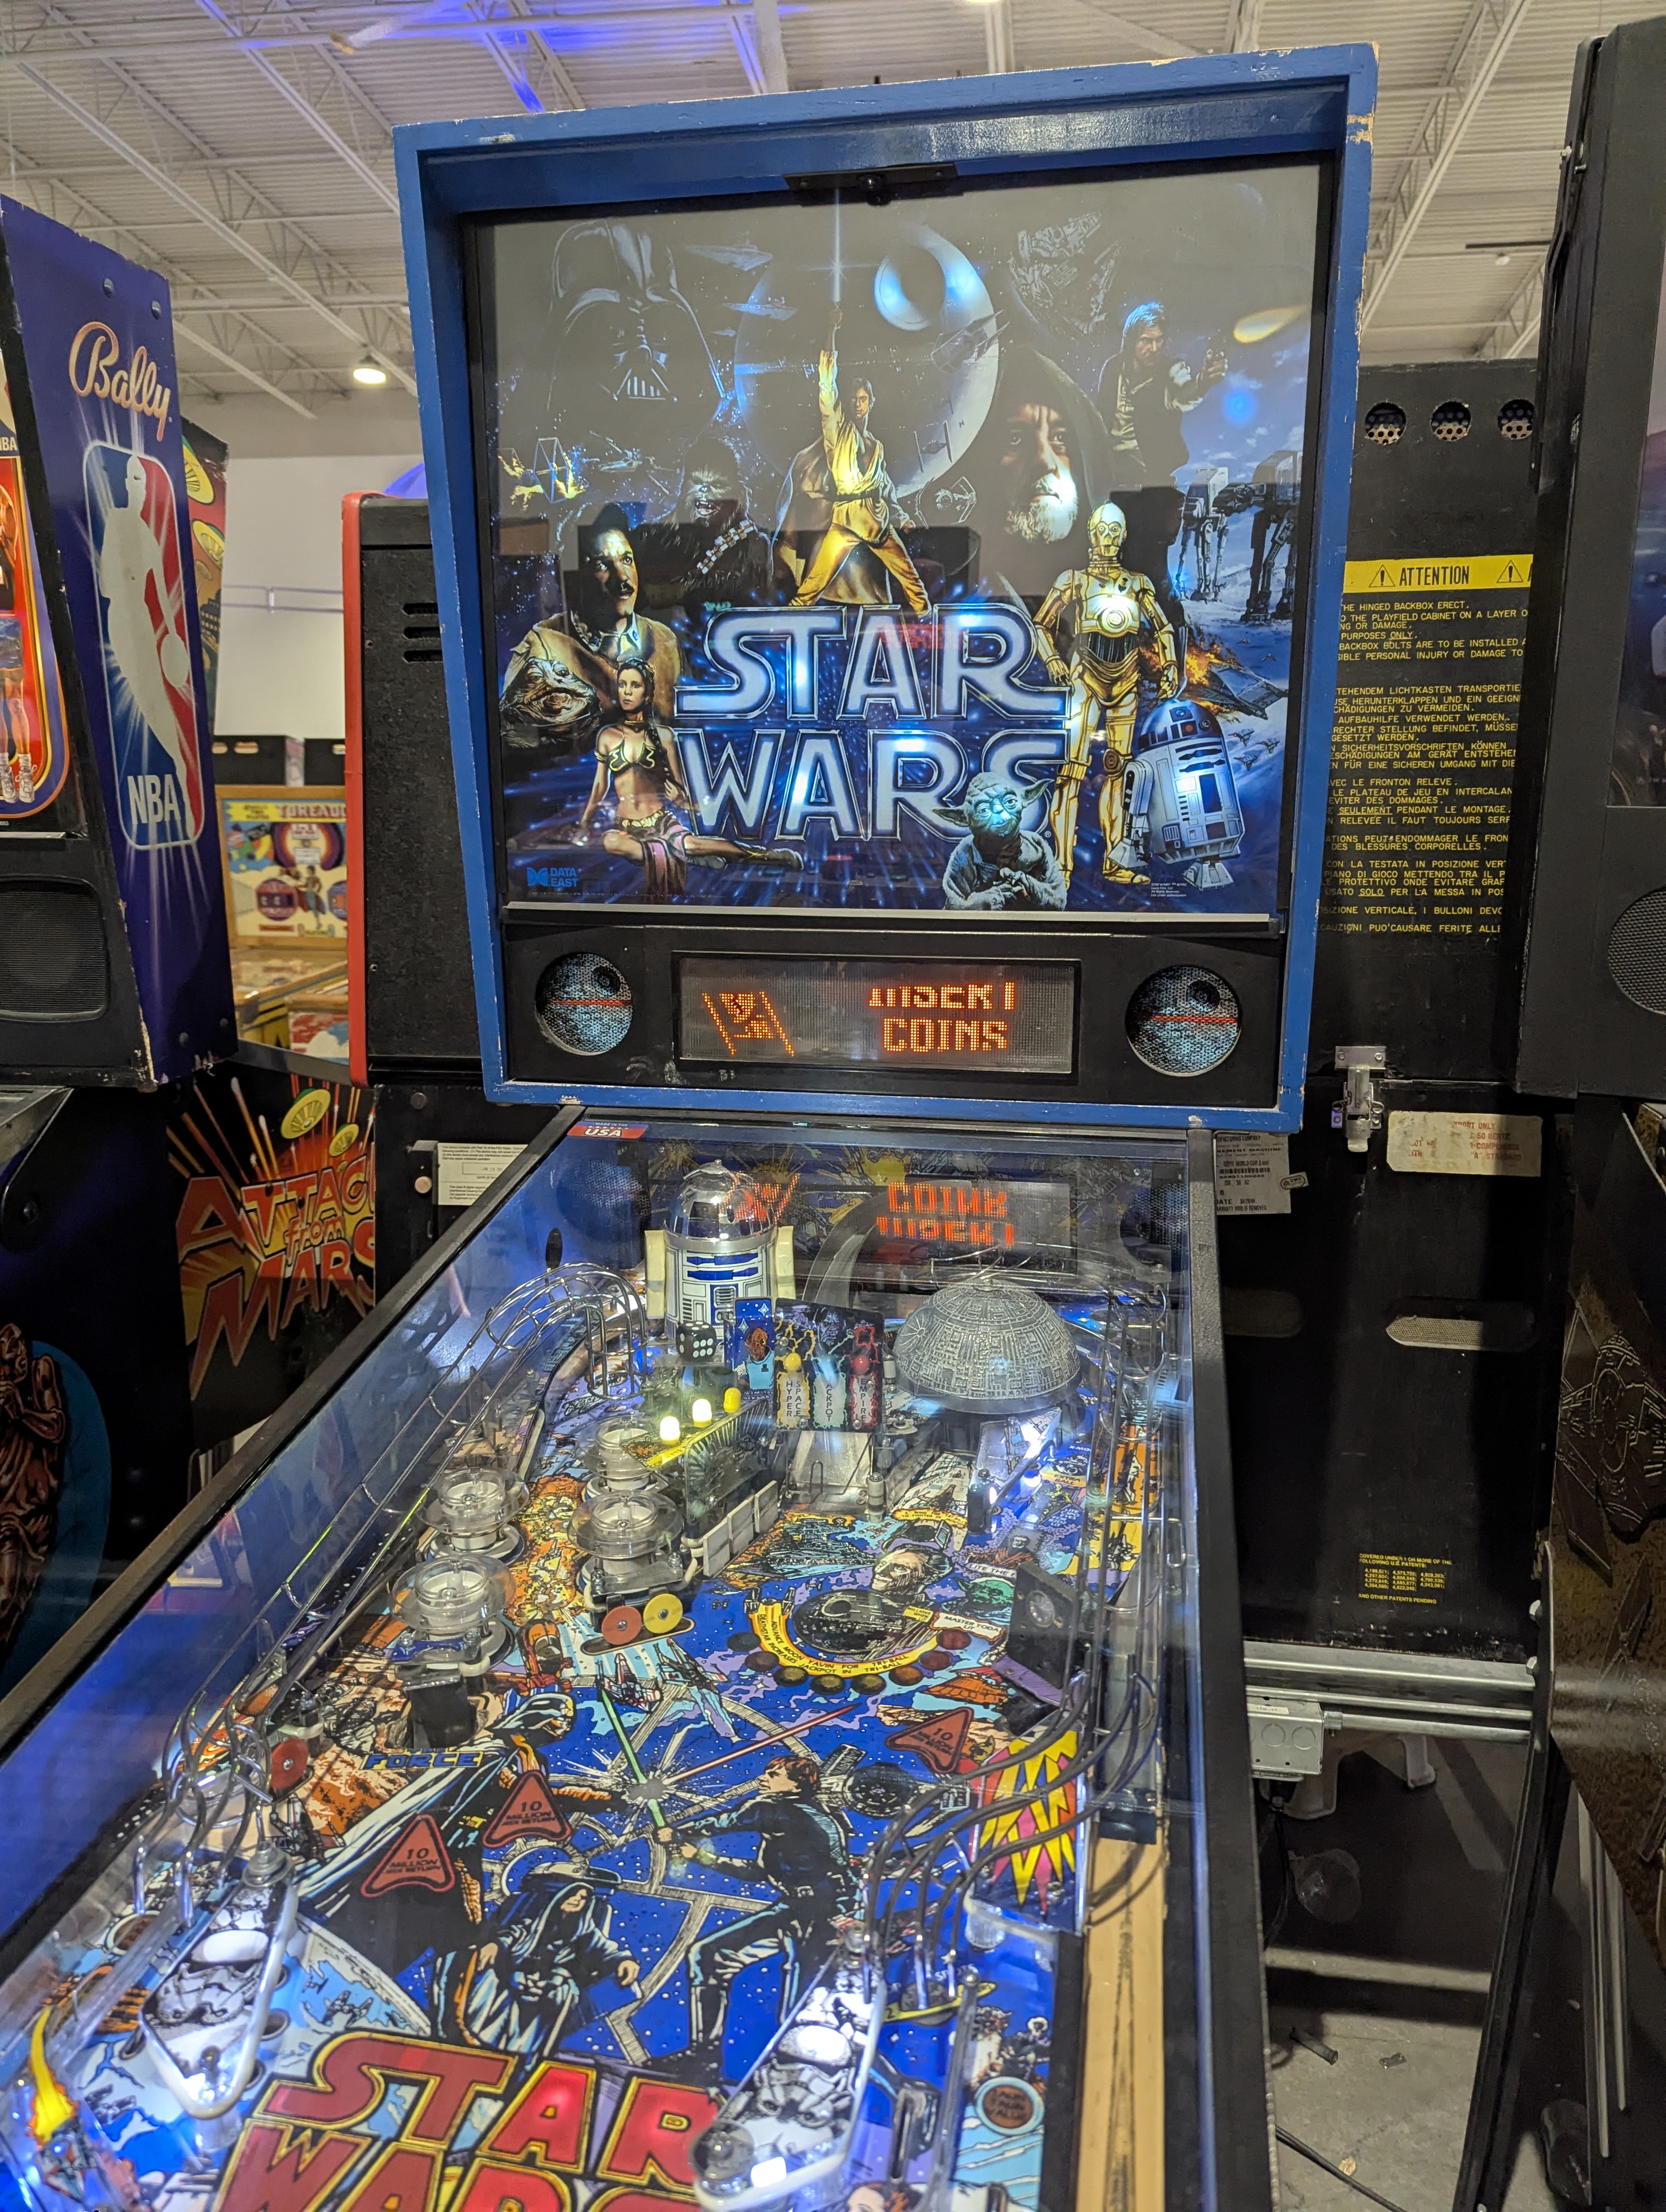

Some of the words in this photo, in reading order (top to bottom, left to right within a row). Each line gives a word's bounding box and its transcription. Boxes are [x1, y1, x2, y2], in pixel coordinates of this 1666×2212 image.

[69, 321, 172, 441] Bally
[0, 436, 18, 451] BA
[1399, 565, 1470, 586] ATTENTION
[1394, 602, 1433, 610] BACKBOX
[1372, 613, 1418, 621] PLAYFIELD
[1421, 612, 1457, 620] CABINET
[1487, 610, 1516, 618] LAYER
[1372, 621, 1413, 629] DAMAGE.
[1341, 632, 1386, 640] PURPOSES
[1339, 642, 1379, 650] BACKBOX
[1470, 639, 1518, 647] INSTALLED
[1366, 652, 1411, 660] PERSONAL
[1417, 651, 1449, 659] INJURY
[1471, 650, 1506, 658] DAMAGE
[674, 604, 1071, 720] STAR
[1389, 686, 1452, 694] LICHTKASTEN
[1353, 696, 1438, 705] HERUNTERKLAPPEN
[1338, 715, 1399, 723] AUFBAUHILFE
[1380, 725, 1426, 733] STELLUNG
[1342, 743, 1464, 752] SICHERHEITSVORSCHRIFTEN
[1471, 740, 1506, 750] KÖNNEN
[1428, 748, 1458, 758] GERÄT
[1344, 760, 1362, 769] FÜR
[674, 729, 1071, 843] WARS
[127, 774, 180, 826] NBA
[550, 867, 577, 877] DATA
[551, 878, 579, 887] EAST
[883, 1018, 1008, 1053] COINS
[585, 1128, 622, 1137] USA
[176, 1155, 375, 1263] ATTAC
[284, 1217, 345, 1266] from
[944, 1616, 975, 1626] MASTER
[976, 1624, 999, 1632] YODA
[760, 1614, 771, 1641] DEATHSTAR
[768, 1642, 798, 1663] INCREASES
[799, 1663, 836, 1674] JACKPOT
[864, 1662, 902, 1673] TRI-BALL
[771, 1621, 785, 1644] ADVANCE
[783, 1646, 805, 1661] MOON
[808, 1659, 835, 1669] YAVIN
[872, 1655, 908, 1667] TRI-BALL
[933, 1728, 953, 1740] 10
[364, 1752, 479, 1767] FORCE
[522, 1801, 542, 1812] 10
[407, 1848, 429, 1859] 10
[253, 2031, 727, 2194] STAR
[216, 2117, 701, 2212] WA
